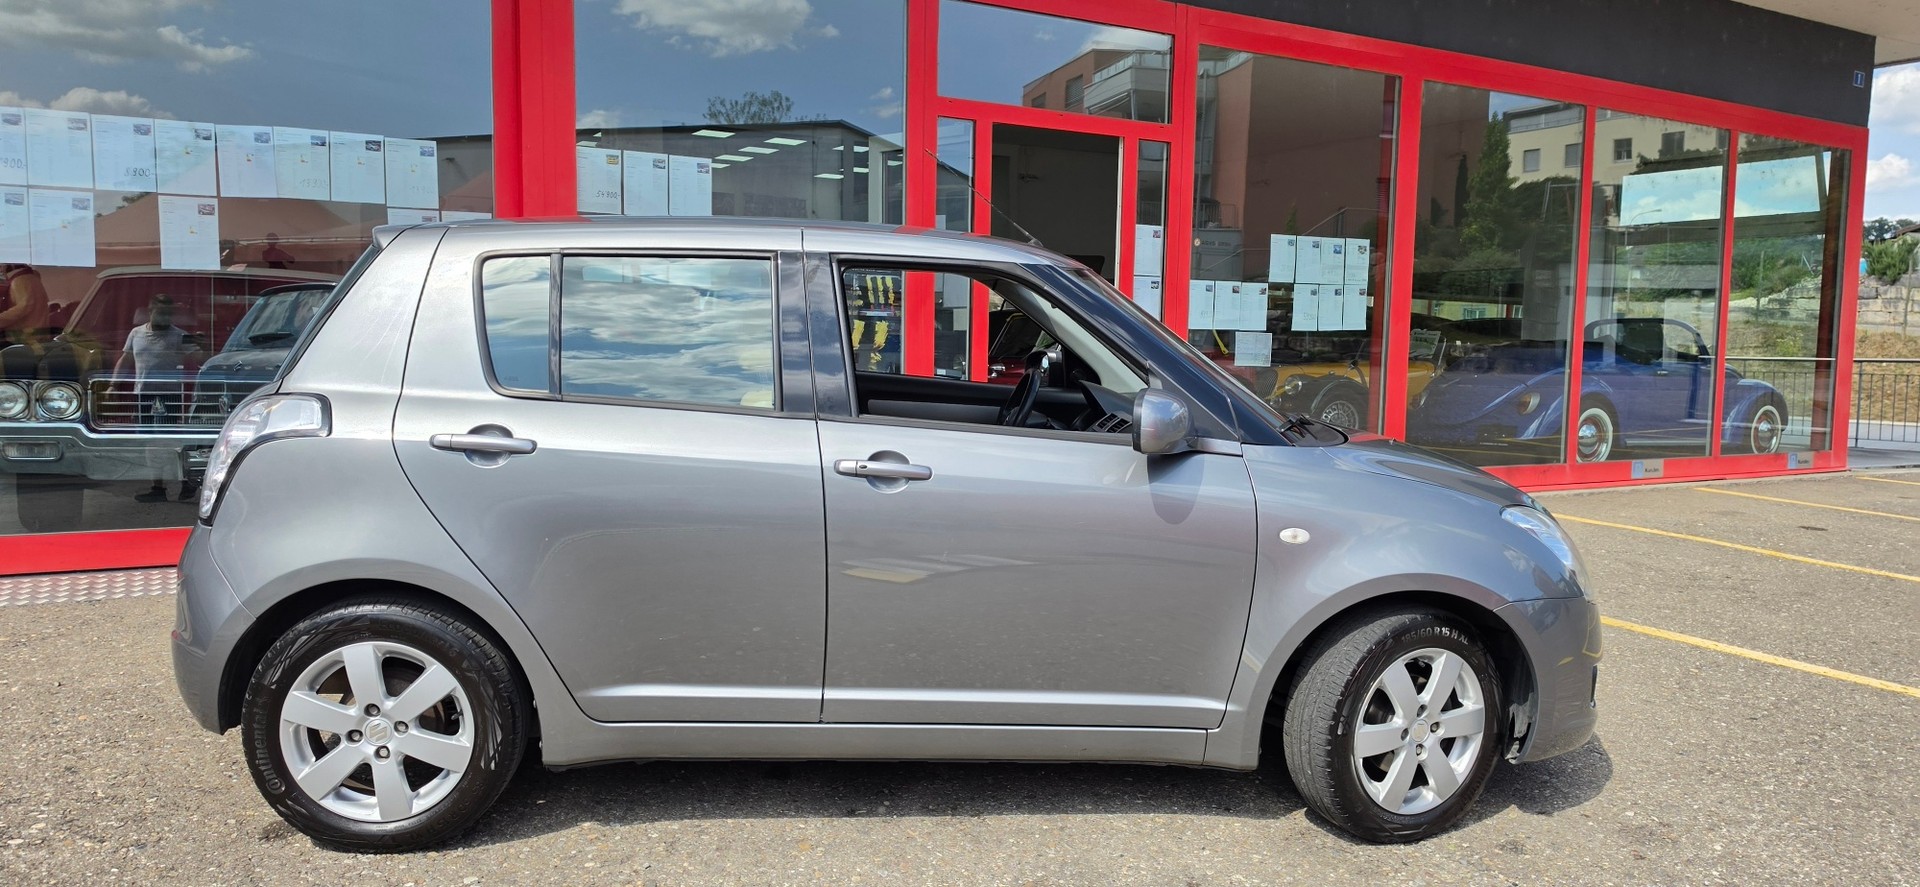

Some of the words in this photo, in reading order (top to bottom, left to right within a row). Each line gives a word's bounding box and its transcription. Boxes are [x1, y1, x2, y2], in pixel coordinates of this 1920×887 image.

[1434, 626, 1441, 637] R
[1441, 626, 1450, 637] 15
[1451, 629, 1459, 640] H
[1459, 634, 1469, 645] XL
[253, 707, 286, 795] Continental
